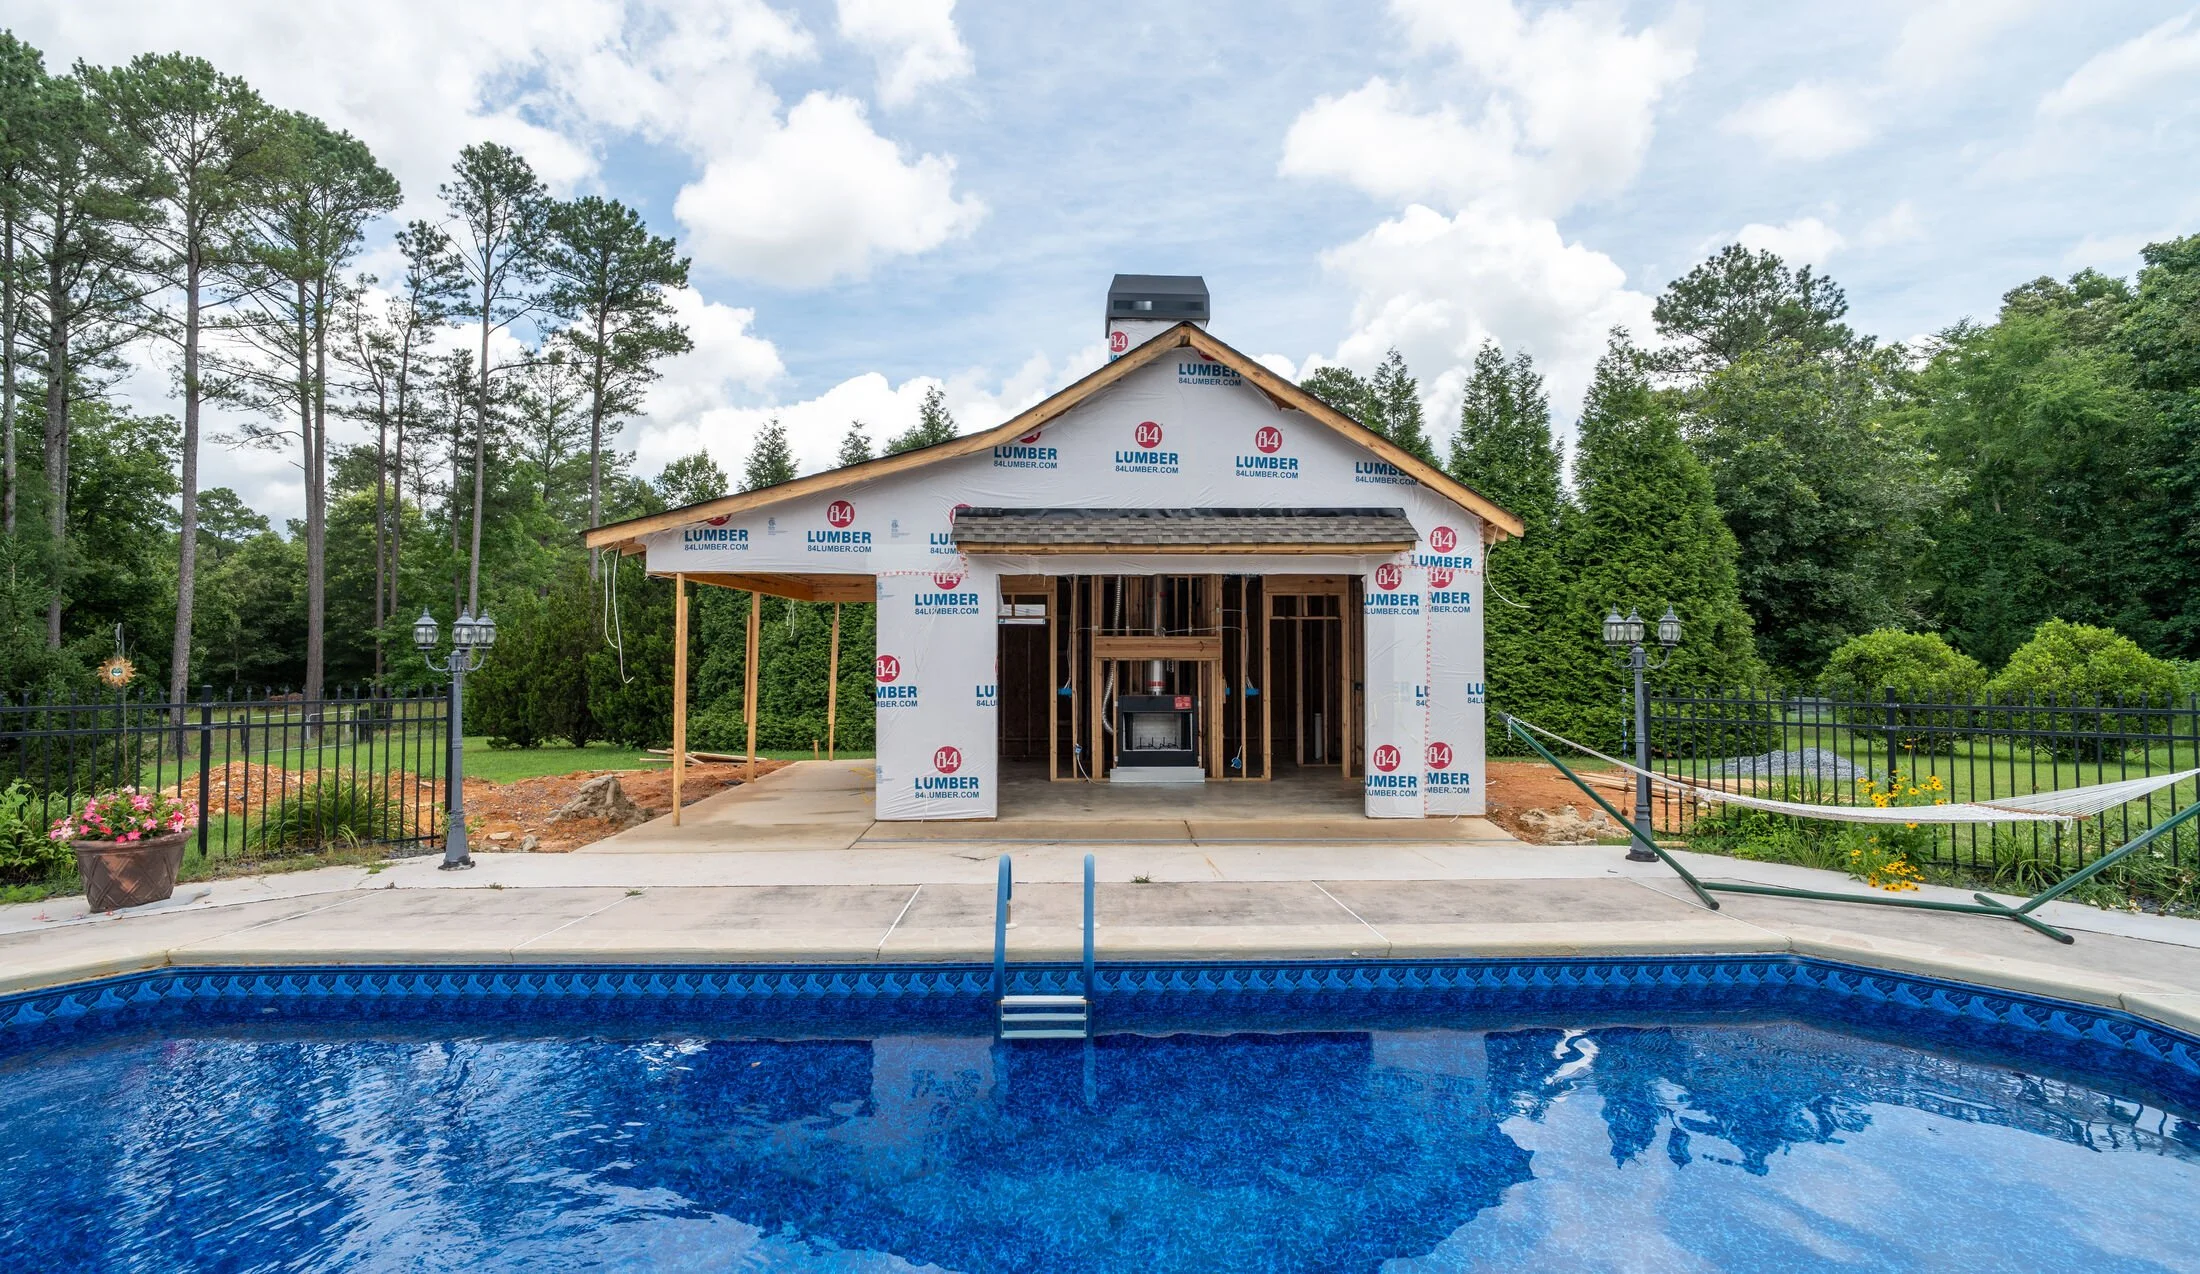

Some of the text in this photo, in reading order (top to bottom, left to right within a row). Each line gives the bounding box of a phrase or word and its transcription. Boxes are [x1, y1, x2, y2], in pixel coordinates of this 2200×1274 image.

[1178, 377, 1242, 386] 84LUMBER.COM
[1138, 426, 1160, 443] 84
[1258, 431, 1278, 448] 84
[994, 446, 1057, 460] LUMBER
[1116, 451, 1178, 465] LUMBER
[994, 460, 1057, 469] 84LUMBER.COM
[1116, 465, 1178, 474] 84LUMBER.COM
[1236, 456, 1298, 470] LUMBER
[1236, 470, 1298, 479] 84LUMBER.COM
[1356, 476, 1418, 486] 84LUMBER.COM
[830, 506, 852, 522] 84
[684, 529, 748, 542] LUMBER
[808, 530, 872, 544] LUMBER
[1432, 530, 1454, 548] 84
[684, 543, 748, 551] 84LUMBER.COM
[808, 544, 872, 552] 84LUMBER.COM
[1411, 555, 1472, 568] LUMBER
[1378, 568, 1400, 585] 84
[914, 593, 978, 606] LUMBER
[936, 751, 958, 768] 84
[1376, 749, 1398, 767] 84
[1428, 746, 1450, 764] 84
[914, 776, 979, 789] LUMBER
